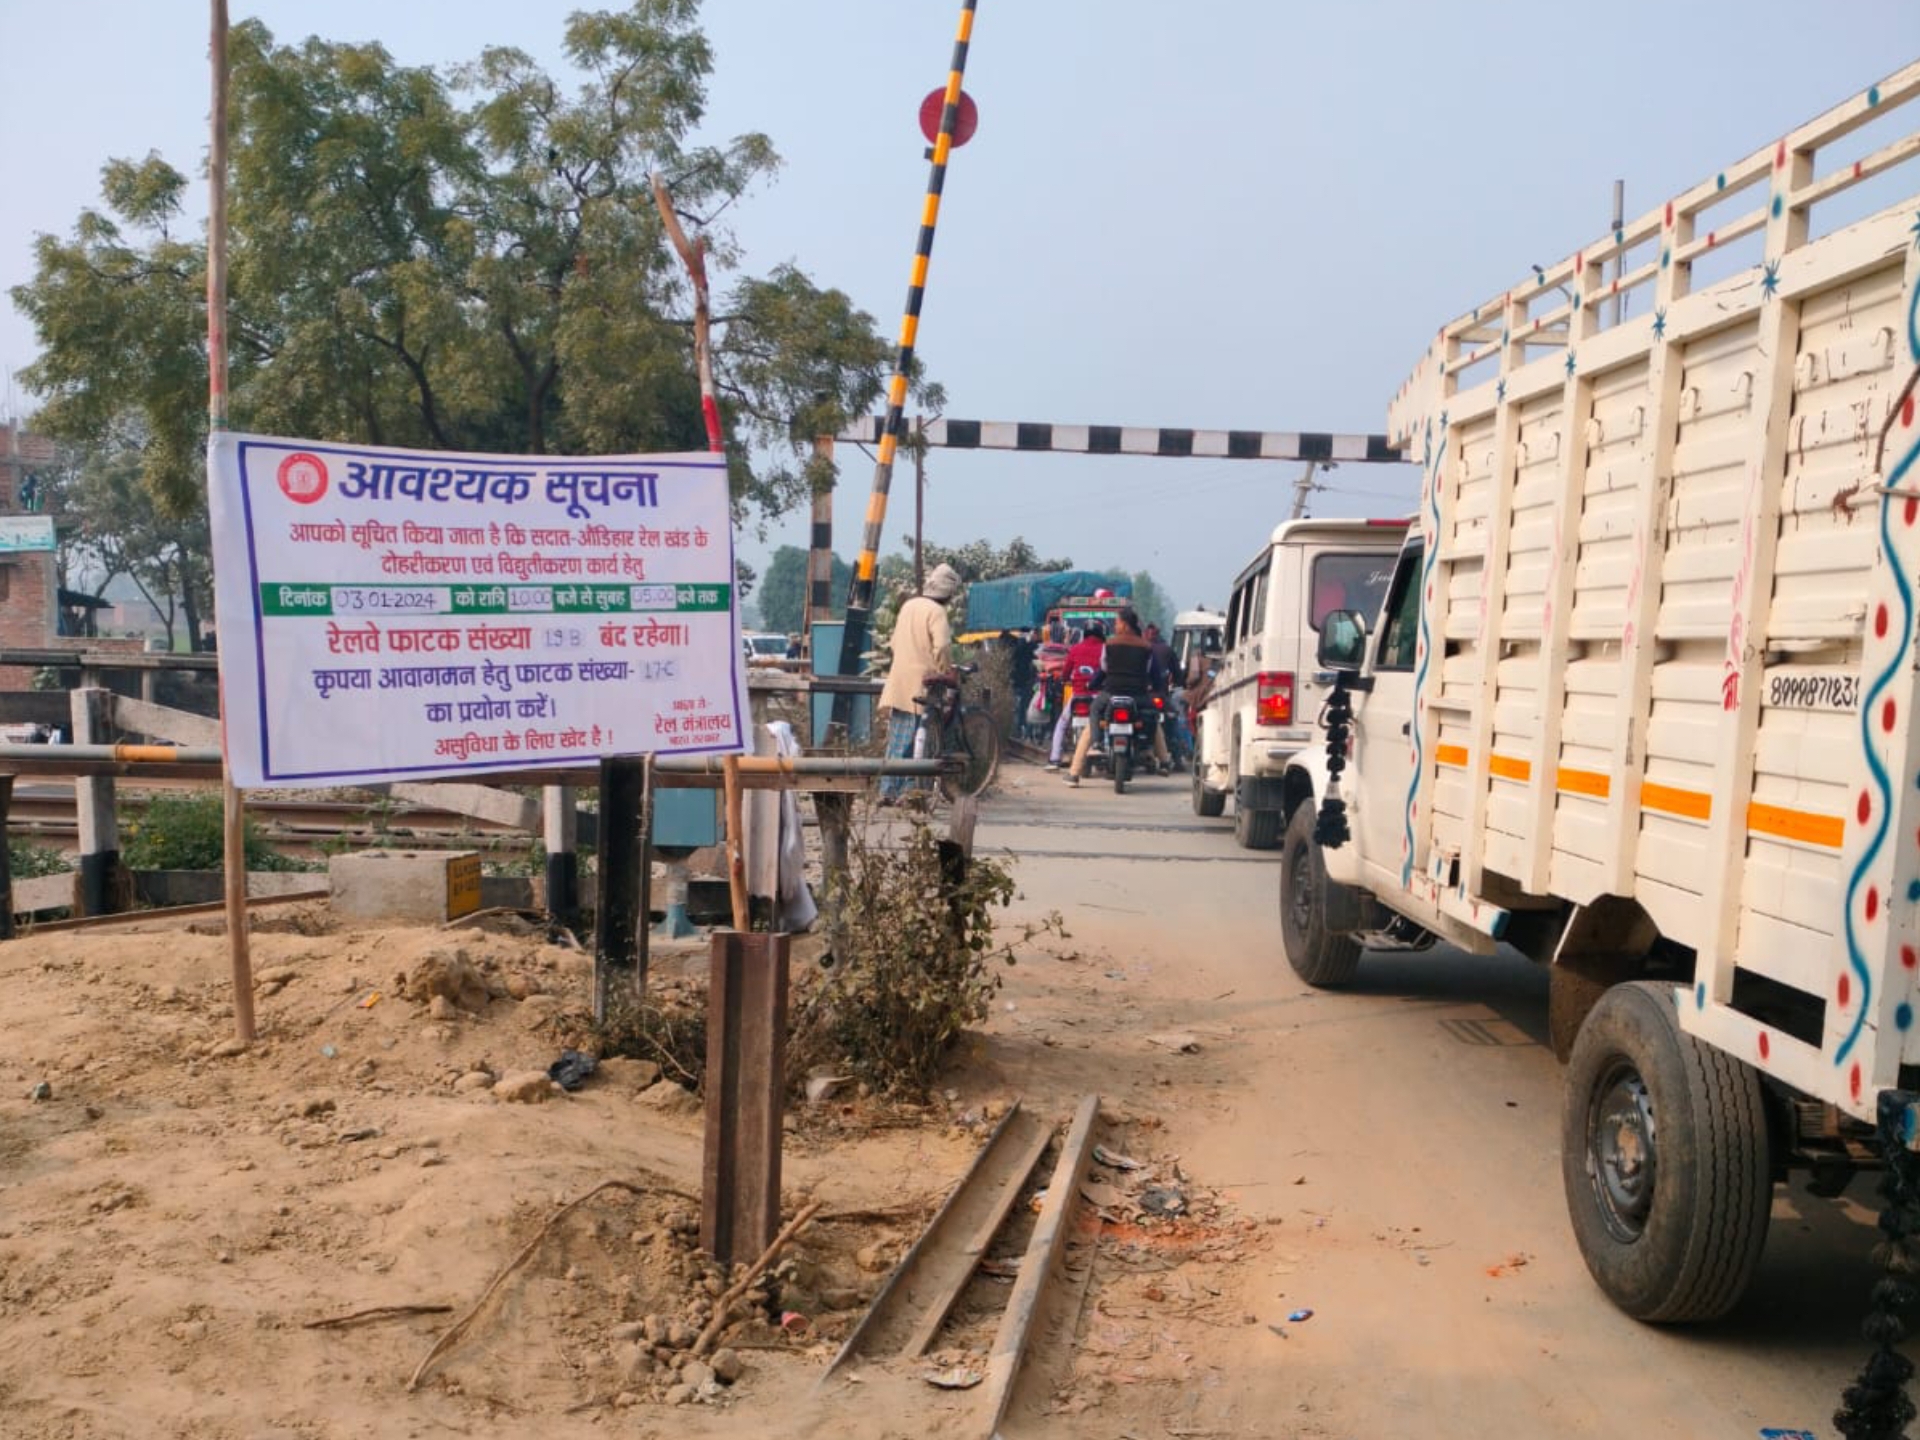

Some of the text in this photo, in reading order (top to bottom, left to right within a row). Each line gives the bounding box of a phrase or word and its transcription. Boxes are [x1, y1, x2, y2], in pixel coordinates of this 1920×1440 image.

[338, 462, 536, 503] आवश्यक
[546, 471, 659, 518] सूचना
[290, 518, 345, 543] आपको
[351, 519, 397, 549] सूचित
[403, 520, 443, 545] किया
[449, 526, 485, 545] जाता
[490, 521, 501, 546] है
[505, 522, 526, 546] कि
[639, 524, 661, 546] रेल
[694, 525, 709, 547] के
[382, 550, 646, 580] दोहरीकरण एवं विद्युतीकरण कार्य हेतु
[278, 586, 328, 607] दिनांक
[455, 586, 476, 606] को
[478, 586, 506, 607] रात्रि
[698, 590, 718, 605] तक
[326, 621, 381, 653] रेलवे
[387, 628, 461, 652] फाटक
[467, 622, 531, 651] संख्या
[599, 621, 626, 648] बंद
[312, 668, 371, 699] कृपया
[378, 665, 476, 688] आवागमन
[482, 658, 512, 692] हेतु
[516, 661, 573, 683] फाटक
[425, 702, 452, 723] का
[458, 694, 511, 723] प्रयोग
[654, 711, 732, 734] रेल मंत्रालय
[434, 731, 498, 760] असुविधा
[503, 729, 520, 751] के
[525, 728, 555, 751] लिए
[560, 726, 587, 748] खेद
